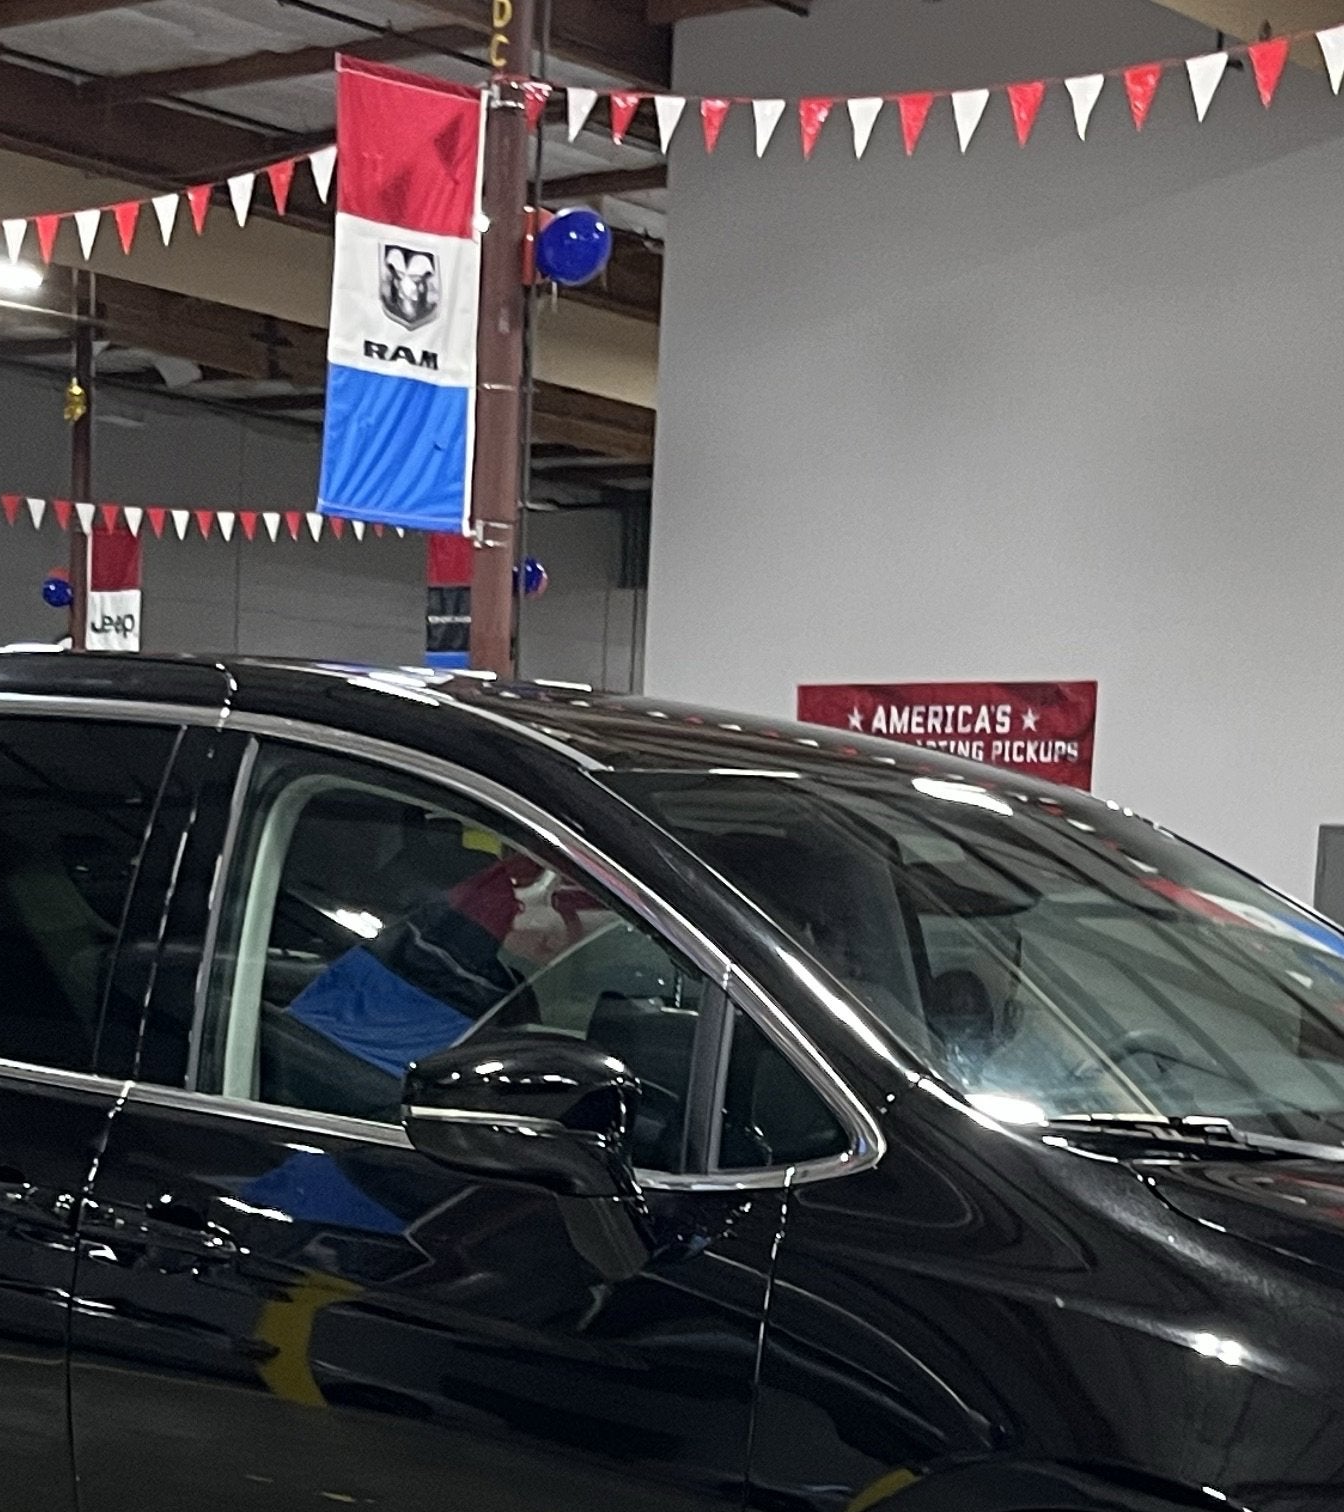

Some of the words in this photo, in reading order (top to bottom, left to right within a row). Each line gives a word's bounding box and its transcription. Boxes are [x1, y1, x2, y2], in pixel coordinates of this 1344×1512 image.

[363, 339, 439, 371] RAM
[871, 704, 1012, 735] AMERICA'S
[991, 739, 1079, 764] PICKUPS
